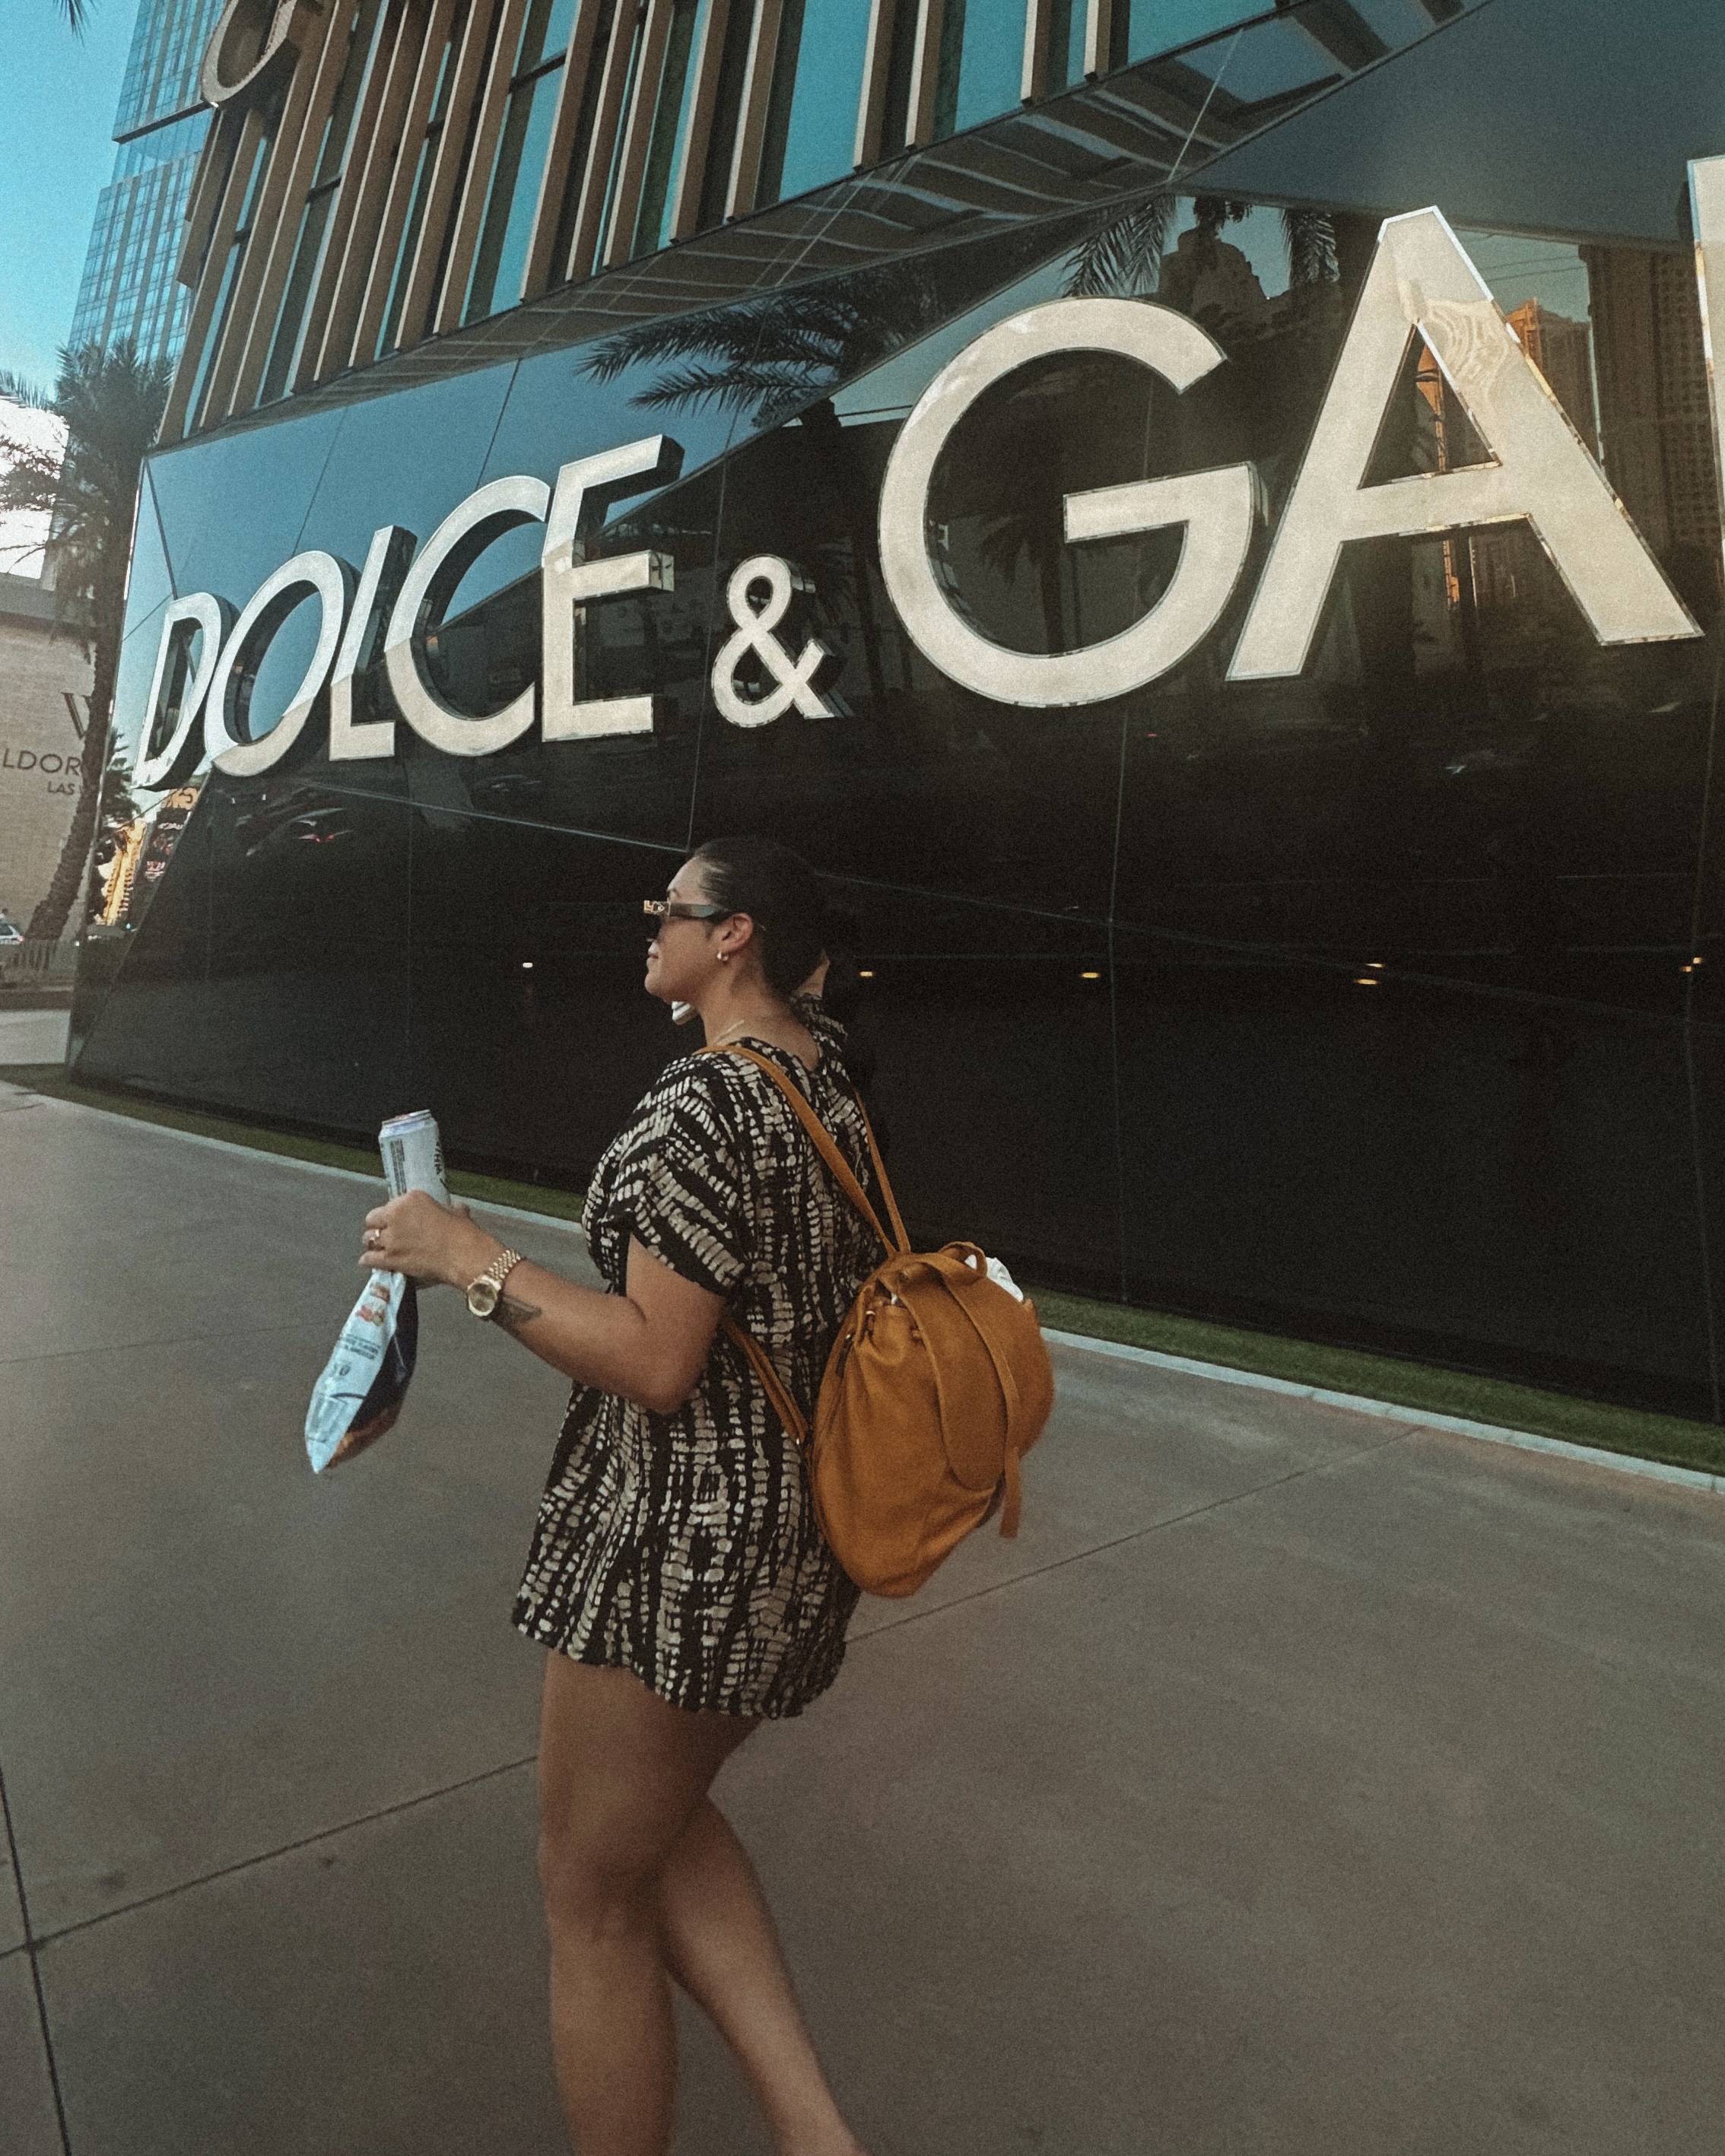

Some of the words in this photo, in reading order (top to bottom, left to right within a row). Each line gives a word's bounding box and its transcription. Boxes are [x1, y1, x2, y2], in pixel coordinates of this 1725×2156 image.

[131, 433, 669, 789] DOLCE
[710, 554, 840, 729] &
[878, 156, 1725, 709] GA
[47, 780, 75, 795] LAS
